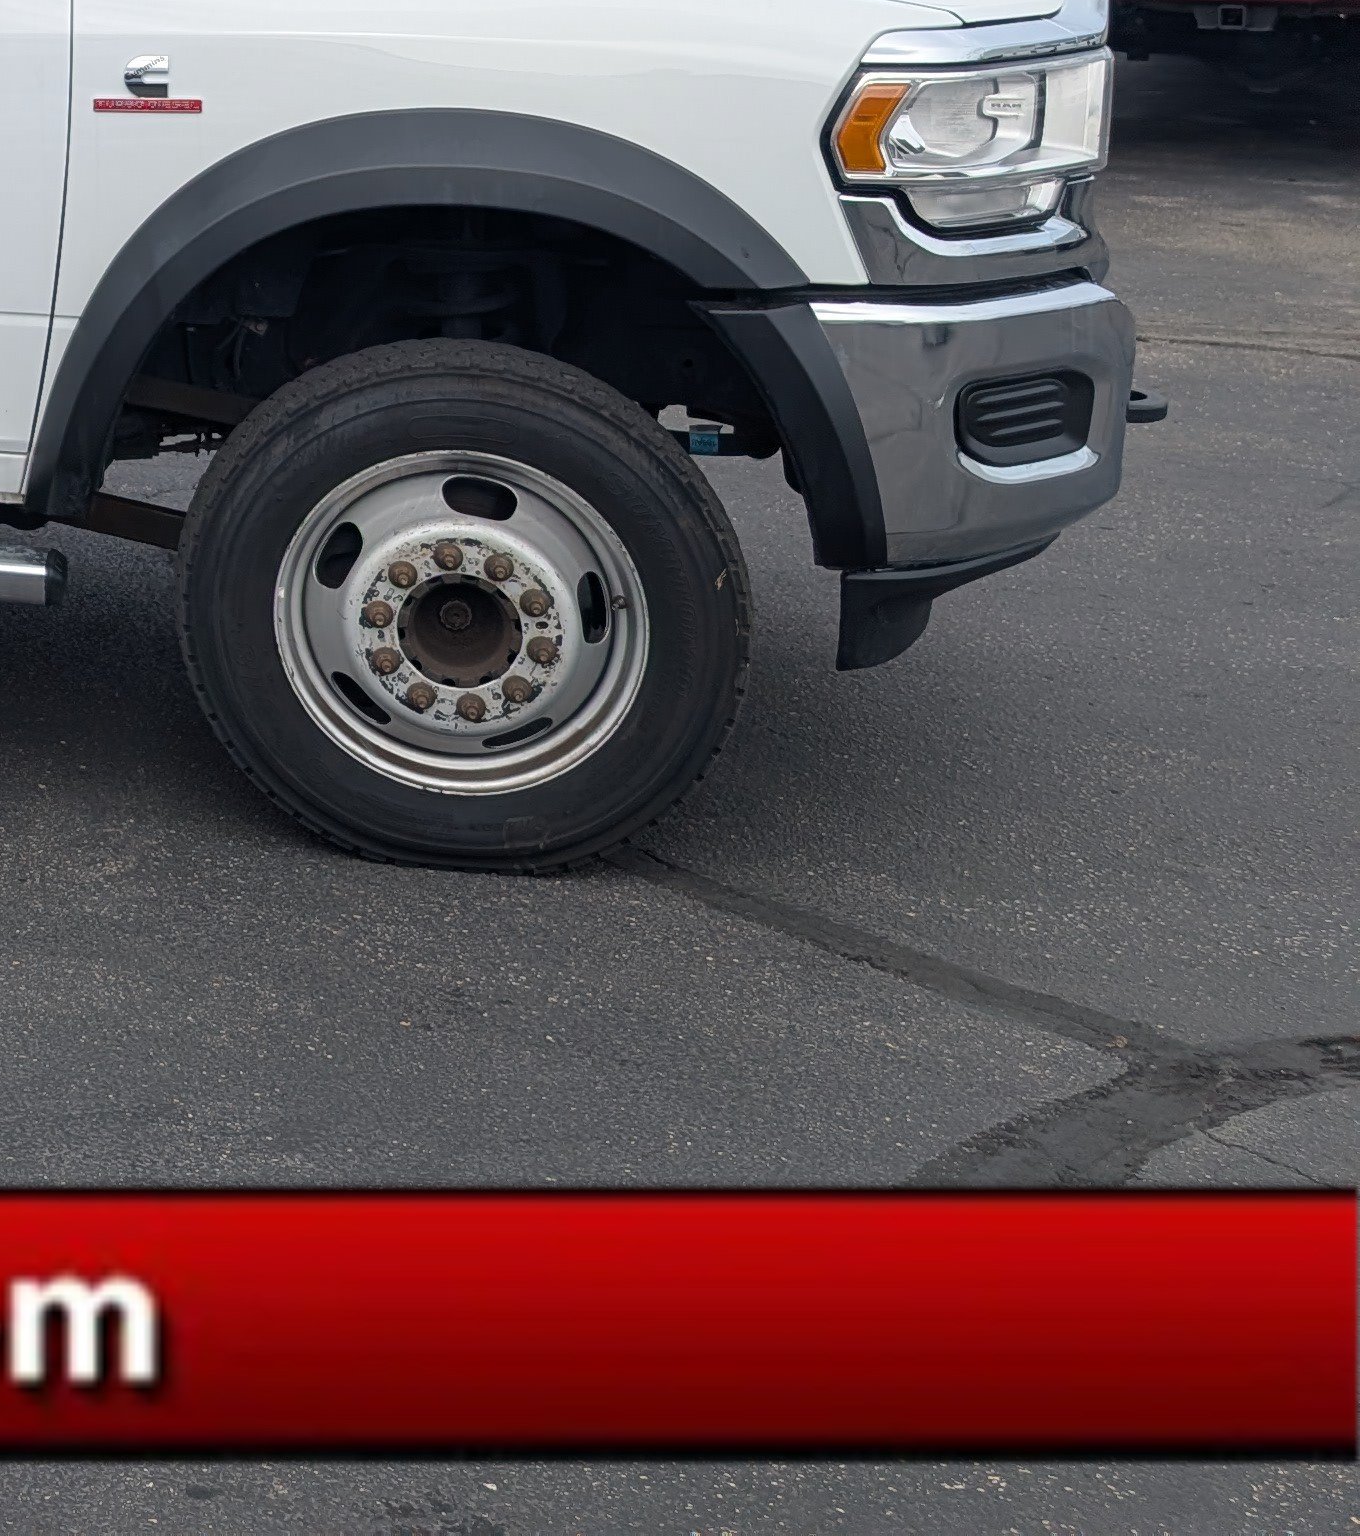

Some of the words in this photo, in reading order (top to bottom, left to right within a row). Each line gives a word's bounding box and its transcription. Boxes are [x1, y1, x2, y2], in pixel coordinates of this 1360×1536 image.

[125, 55, 166, 78] Cummins
[95, 99, 145, 109] TURBO
[147, 99, 200, 110] DIESEL
